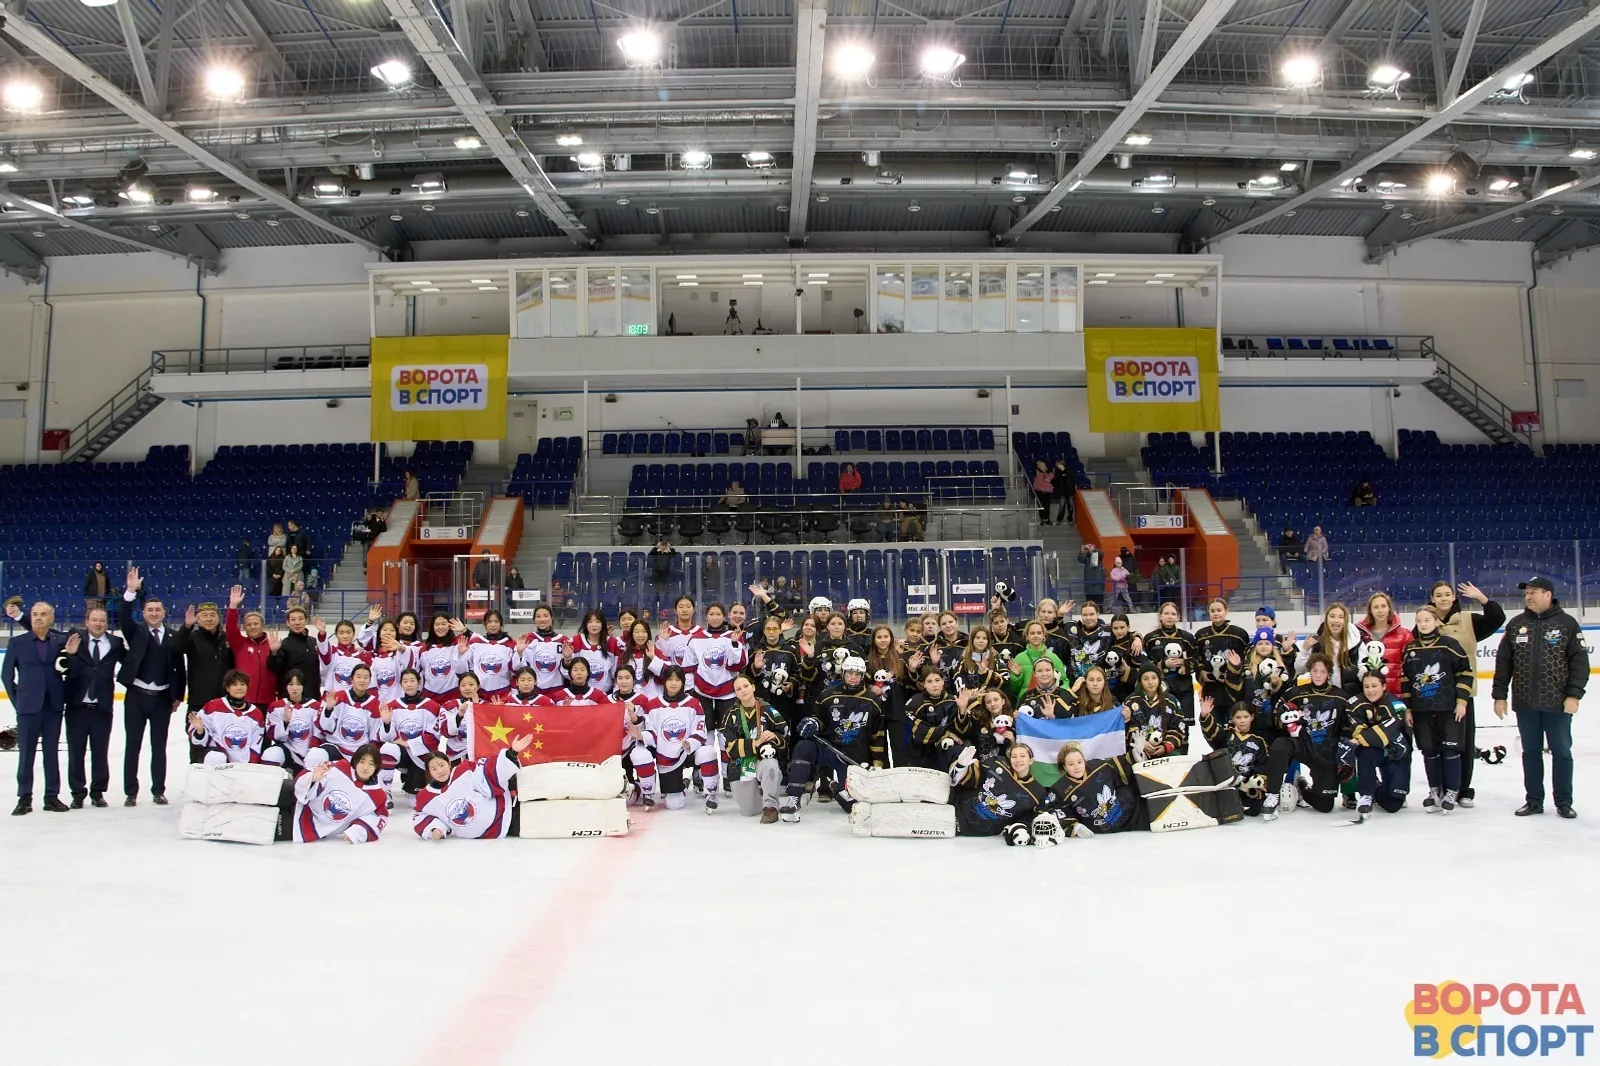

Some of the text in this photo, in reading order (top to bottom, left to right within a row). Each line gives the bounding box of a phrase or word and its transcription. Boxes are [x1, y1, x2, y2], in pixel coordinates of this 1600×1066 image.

[628, 324, 648, 335] 18:03
[1113, 360, 1192, 377] ВОРОТА
[399, 368, 479, 385] ВОРОТА
[1115, 380, 1196, 397] В СПОРТ
[399, 388, 482, 405] В СПОРТ
[1140, 517, 1147, 527] 9
[1169, 517, 1182, 527] 10
[423, 528, 430, 538] 8
[457, 528, 464, 538] 9
[1142, 757, 1170, 768] CCM
[1162, 821, 1189, 829] CCM
